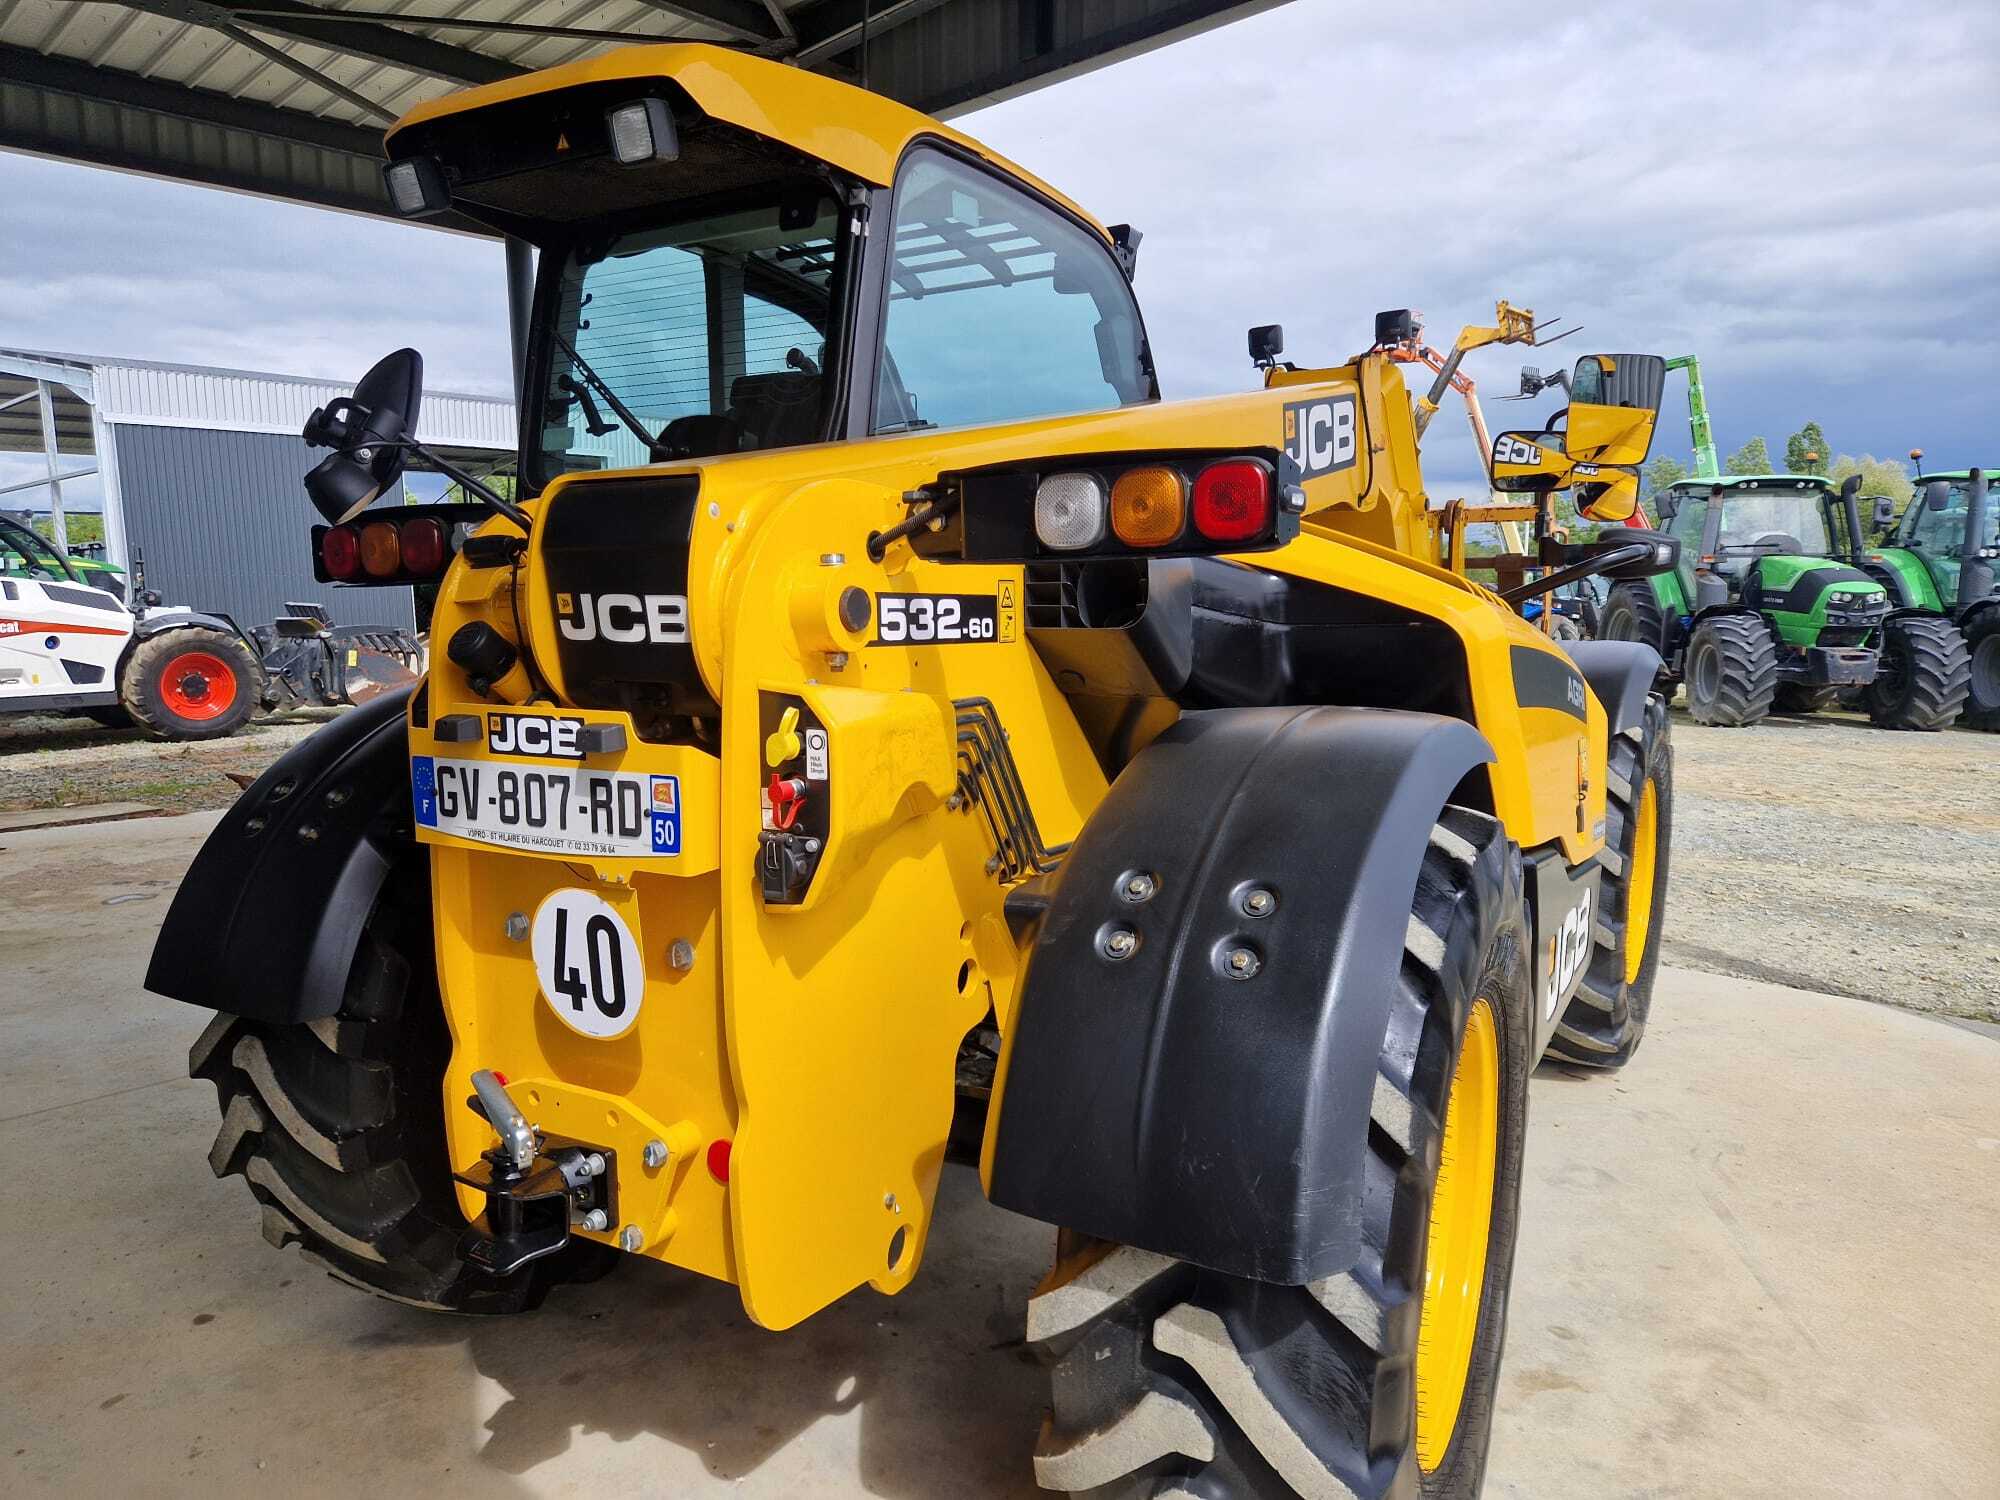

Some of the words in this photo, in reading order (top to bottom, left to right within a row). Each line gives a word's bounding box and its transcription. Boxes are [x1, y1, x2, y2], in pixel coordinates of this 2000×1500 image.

[1286, 401, 1355, 474] JCB
[558, 593, 691, 643] JCB
[490, 717, 584, 757] JCB
[423, 799, 430, 814] F
[437, 766, 642, 837] GV-807-RD
[491, 832, 497, 840] ST
[522, 836, 530, 844] DU
[655, 819, 675, 846] 50
[554, 908, 626, 1019] 40
[1546, 888, 1591, 1022] JCB
